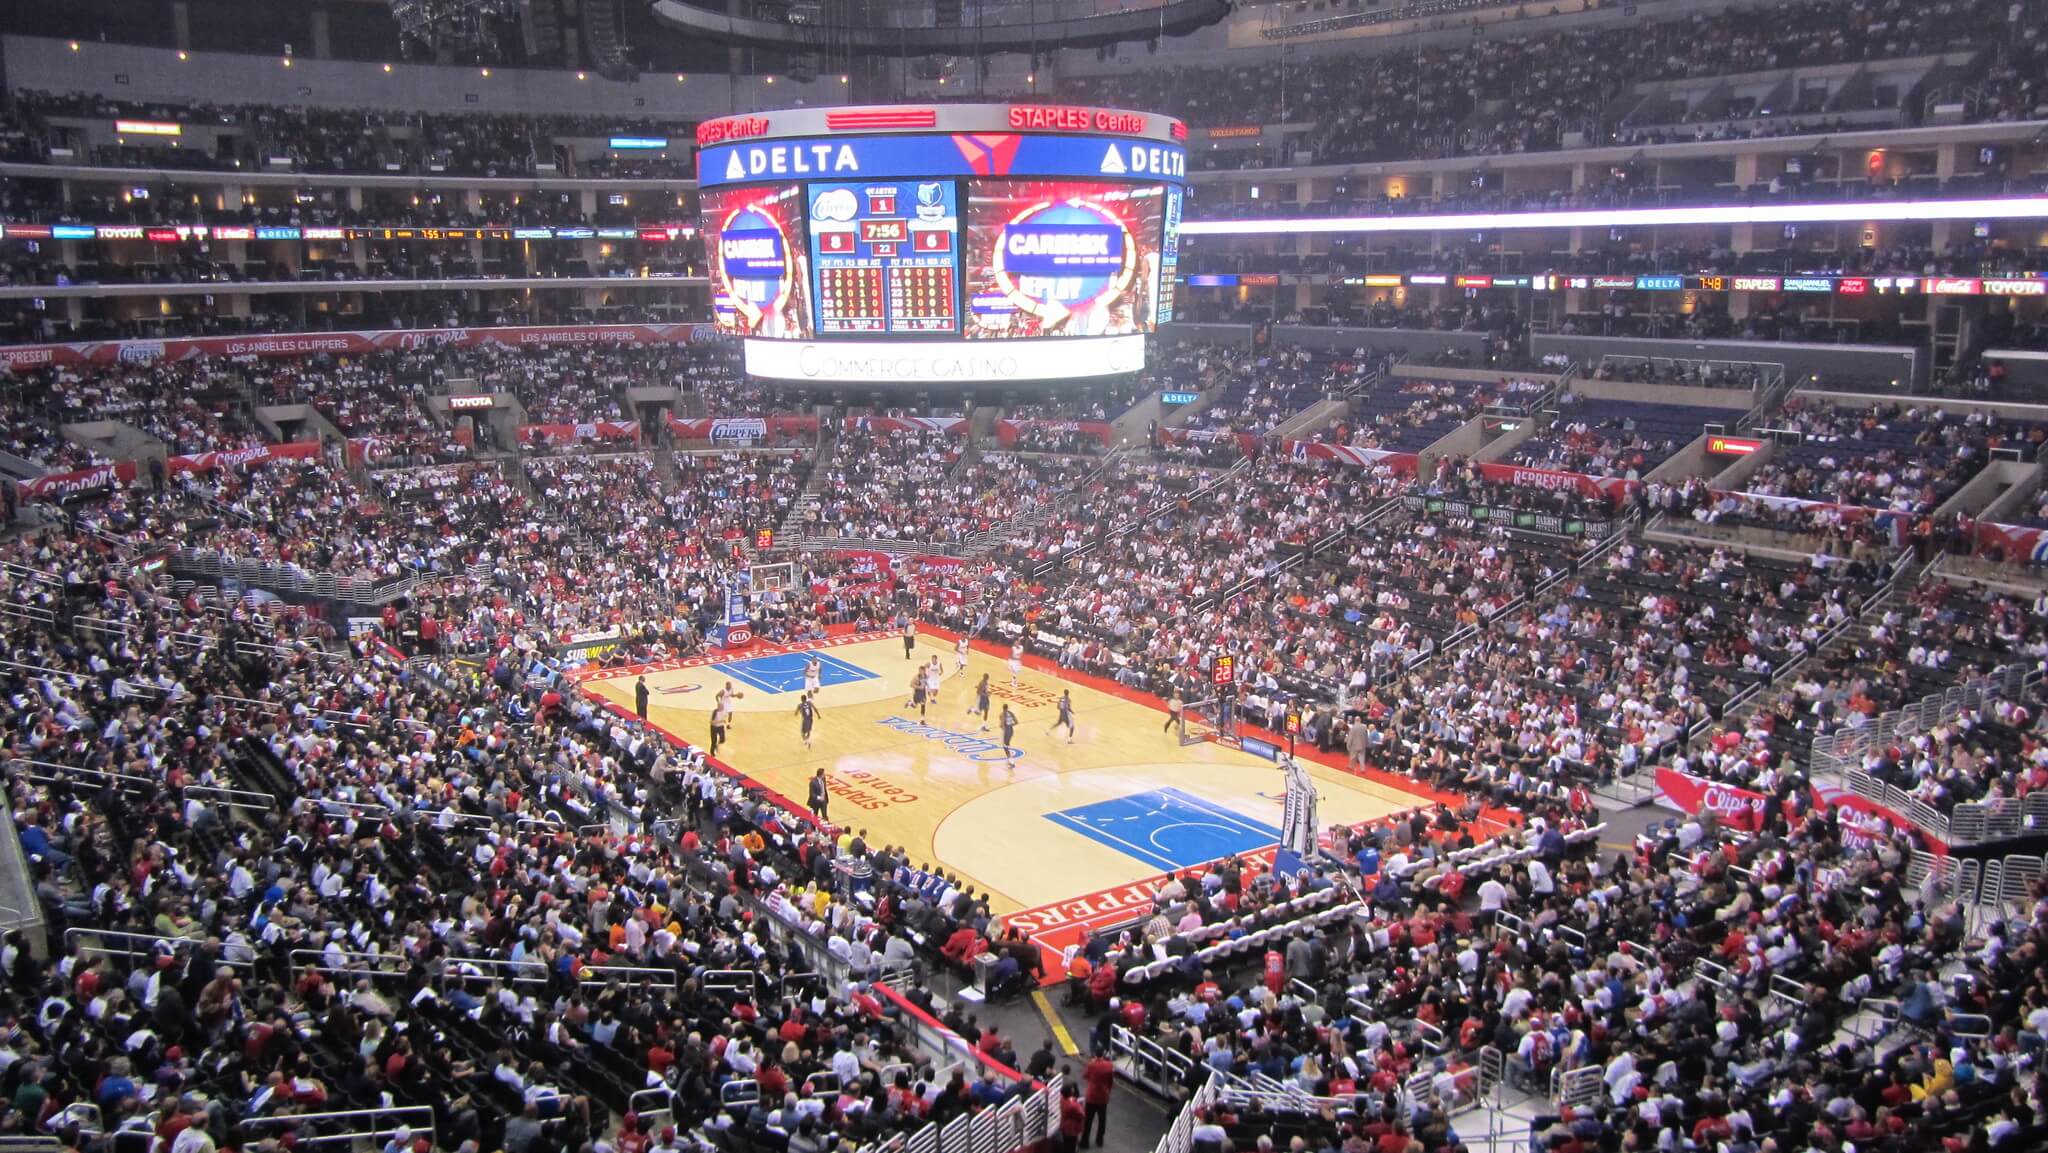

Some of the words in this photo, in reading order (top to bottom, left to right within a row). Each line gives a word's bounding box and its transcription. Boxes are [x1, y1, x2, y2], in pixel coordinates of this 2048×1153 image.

[1009, 108, 1090, 128] STAPLES
[1095, 111, 1146, 132] Center
[723, 118, 768, 137] Center
[750, 144, 859, 174] DELTA
[1131, 147, 1184, 177] DELTA
[879, 200, 887, 211] 1
[98, 228, 144, 238] TOYOTA
[268, 230, 299, 238] DELTA
[866, 224, 900, 238] 7:56
[830, 235, 841, 249] 8
[926, 234, 937, 248] 6
[1648, 278, 1680, 288] DELTA
[1700, 277, 1721, 289] 7:48
[1734, 278, 1776, 290] STAPLES
[1983, 281, 2045, 294] TOYOTA
[521, 333, 540, 343] LOS
[541, 332, 586, 342] ANGELES
[226, 343, 246, 353] LOS
[248, 341, 296, 352] ANGELES
[298, 339, 349, 350] CLIPPERS
[800, 345, 926, 377] COMMERCE
[931, 351, 1017, 377] CASINO
[450, 397, 493, 408] TOYOTA
[713, 424, 762, 439] CLIPPERS
[732, 633, 747, 641] KIA
[574, 668, 632, 682] LOS
[642, 649, 779, 674] ANGELES
[1215, 666, 1231, 682] 22
[843, 769, 919, 803] Center
